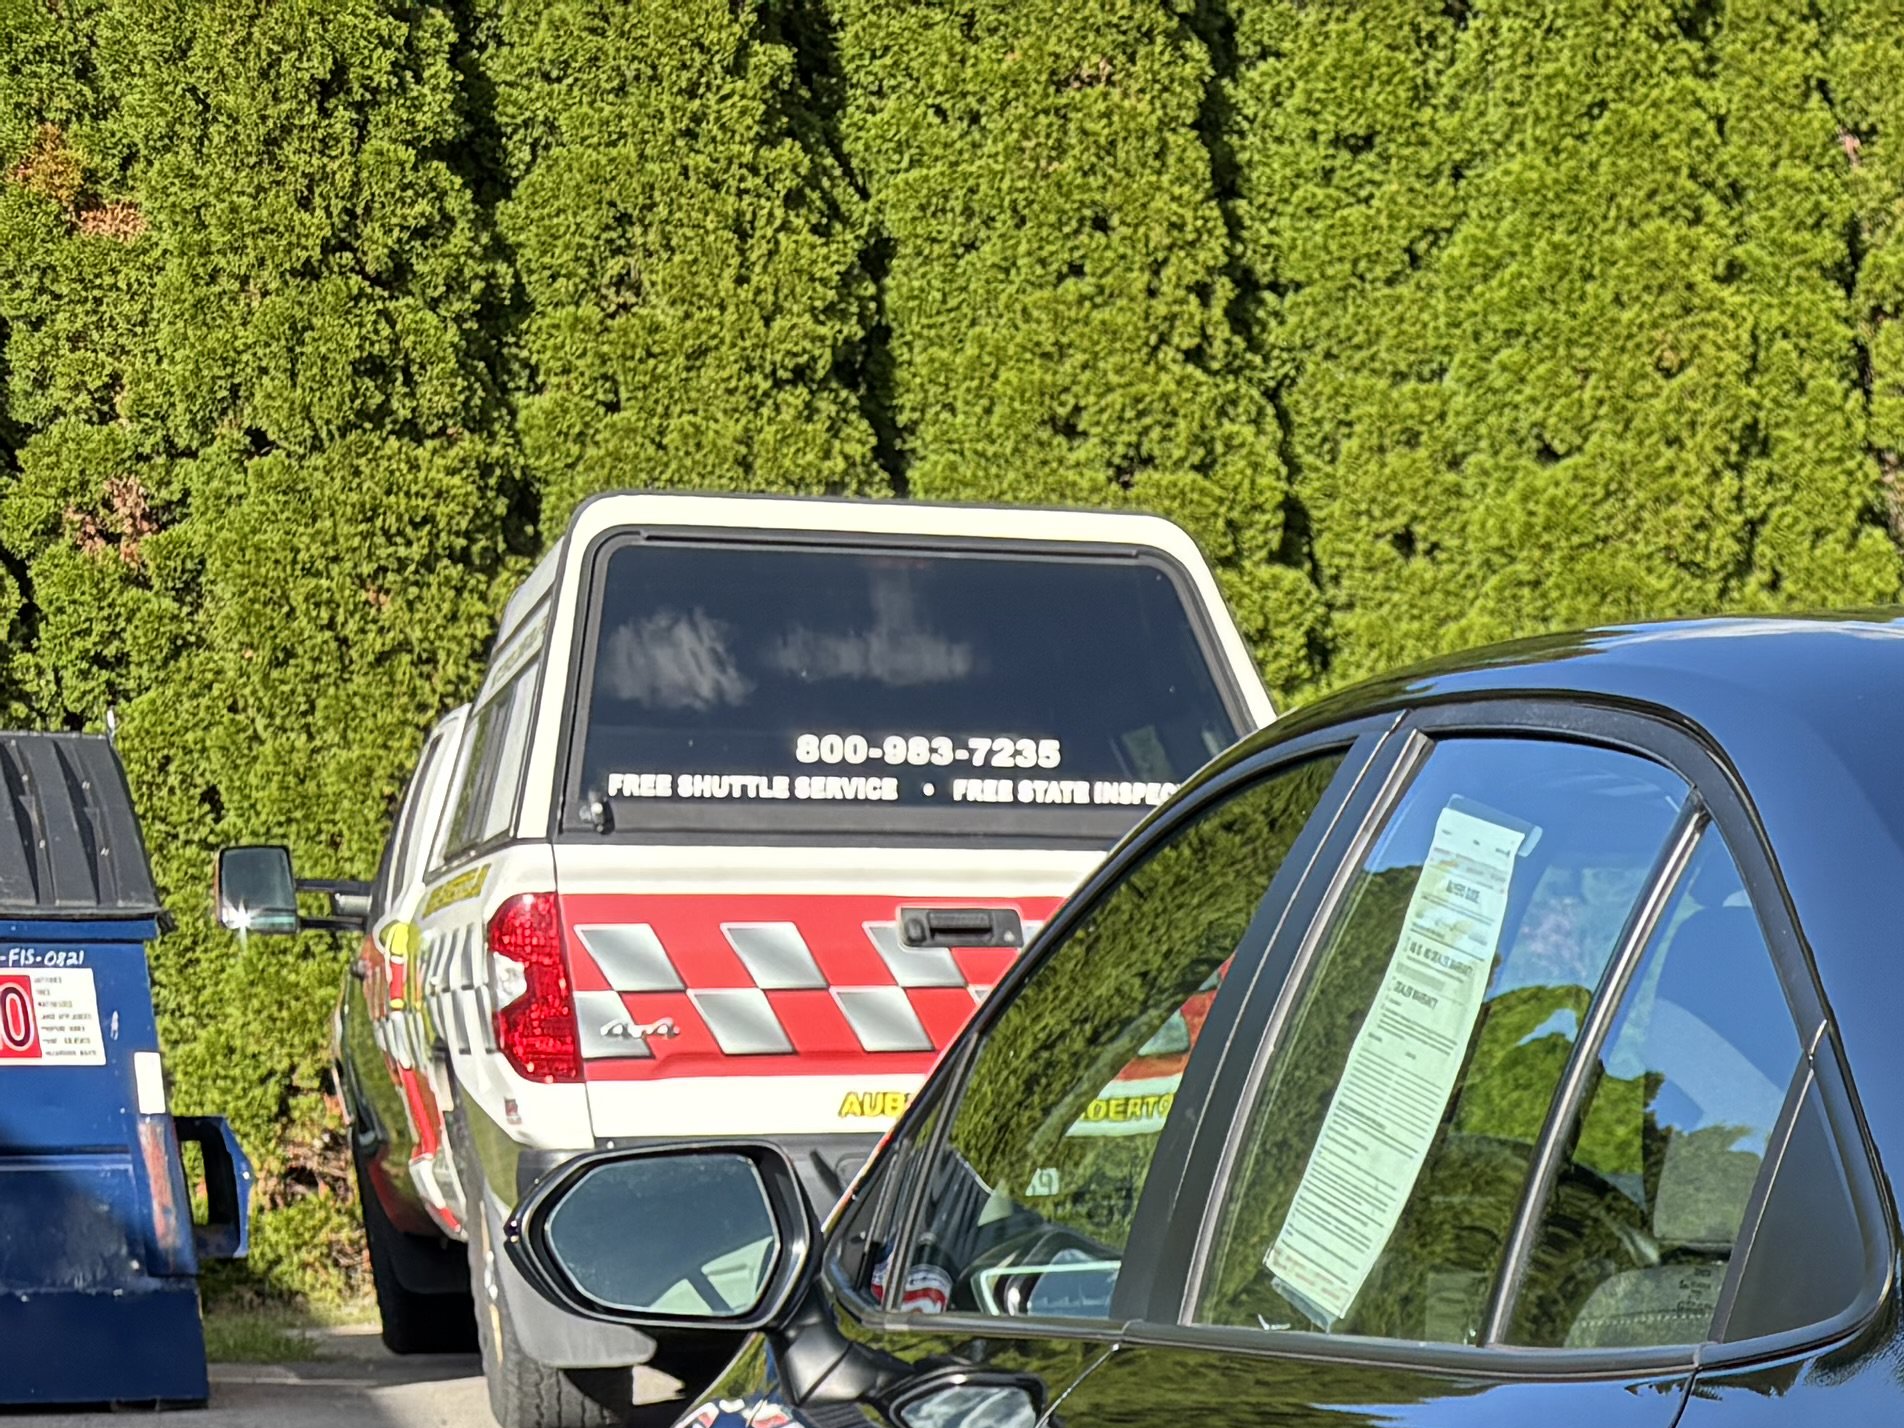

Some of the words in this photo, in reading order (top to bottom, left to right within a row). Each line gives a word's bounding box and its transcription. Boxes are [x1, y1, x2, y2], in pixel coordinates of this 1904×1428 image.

[796, 734, 1061, 768] 800-983-7235
[608, 773, 672, 797] FREE
[677, 774, 790, 799] SHUTTLE
[795, 776, 898, 800] SERVICE
[953, 778, 1013, 801] FREE
[1017, 779, 1090, 803] STATE
[1094, 781, 1181, 805] INSPEC
[838, 1091, 909, 1117] AUB
